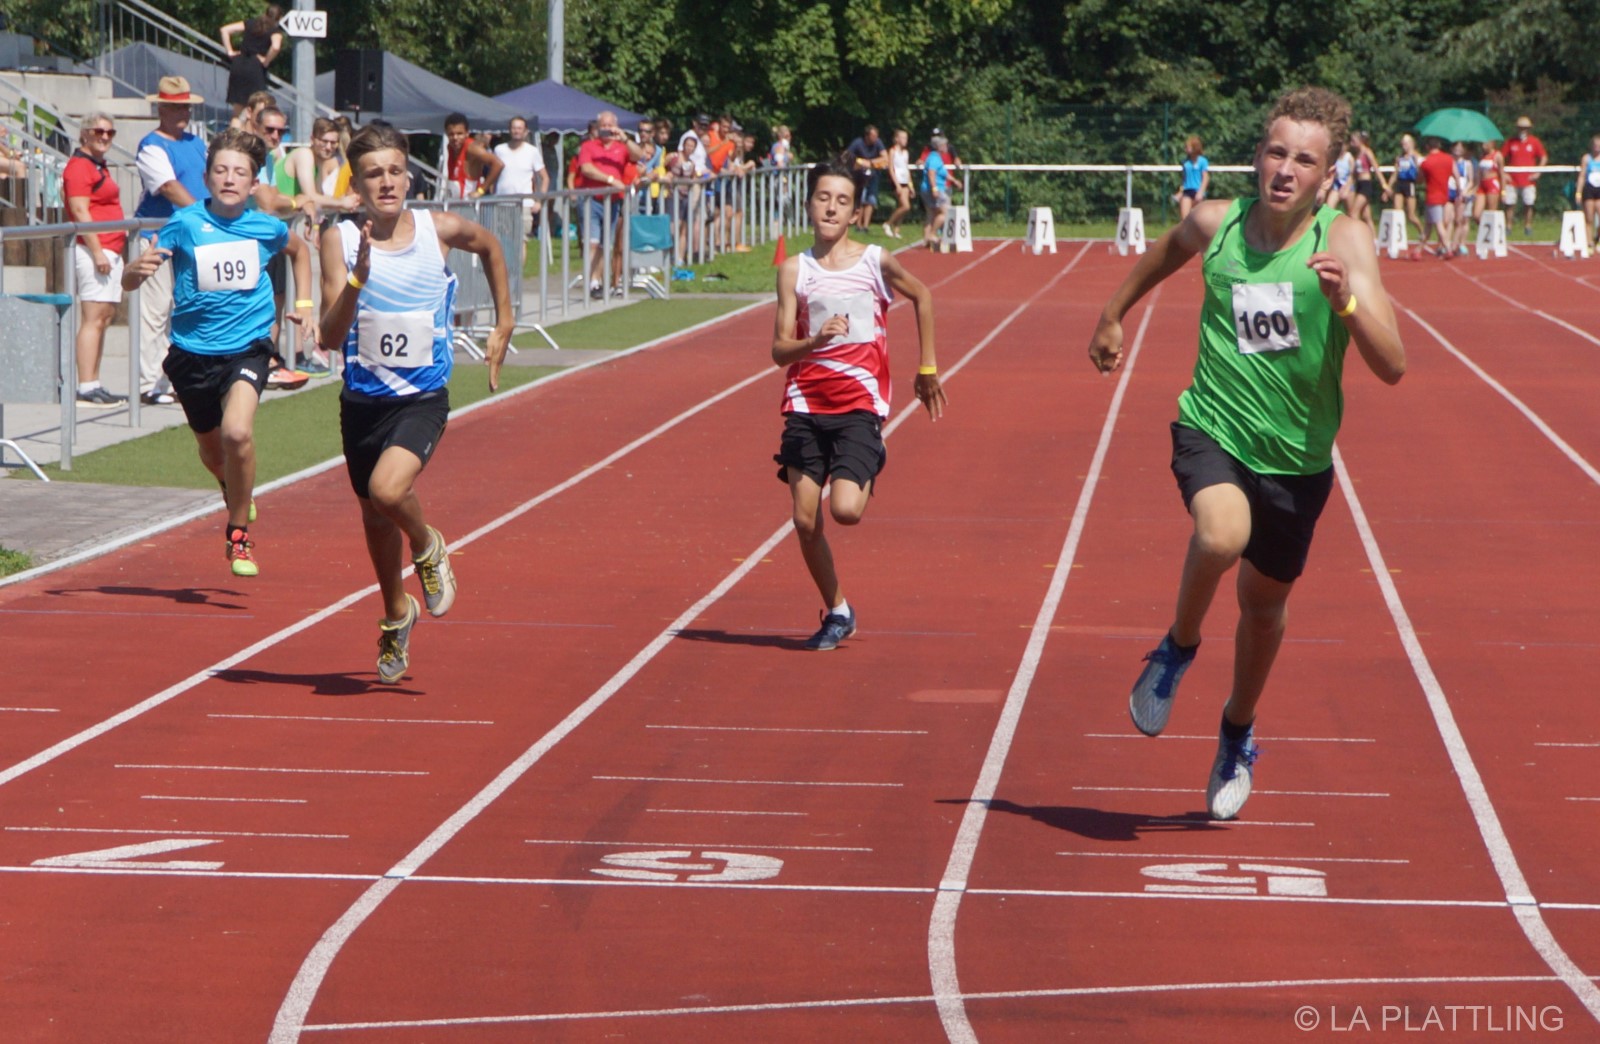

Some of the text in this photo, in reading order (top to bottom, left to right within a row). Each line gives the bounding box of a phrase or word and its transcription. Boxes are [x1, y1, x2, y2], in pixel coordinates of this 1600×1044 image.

[294, 16, 323, 31] WC
[946, 218, 956, 238] 8
[960, 218, 967, 238] 8
[1041, 220, 1048, 239] 7
[1120, 220, 1128, 240] 6
[1134, 220, 1141, 240] 6
[1381, 222, 1390, 242] 3
[1483, 223, 1491, 243] 2
[1568, 224, 1576, 243] 1
[213, 259, 246, 283] 199
[1238, 310, 1290, 340] 160
[380, 333, 408, 357] 62
